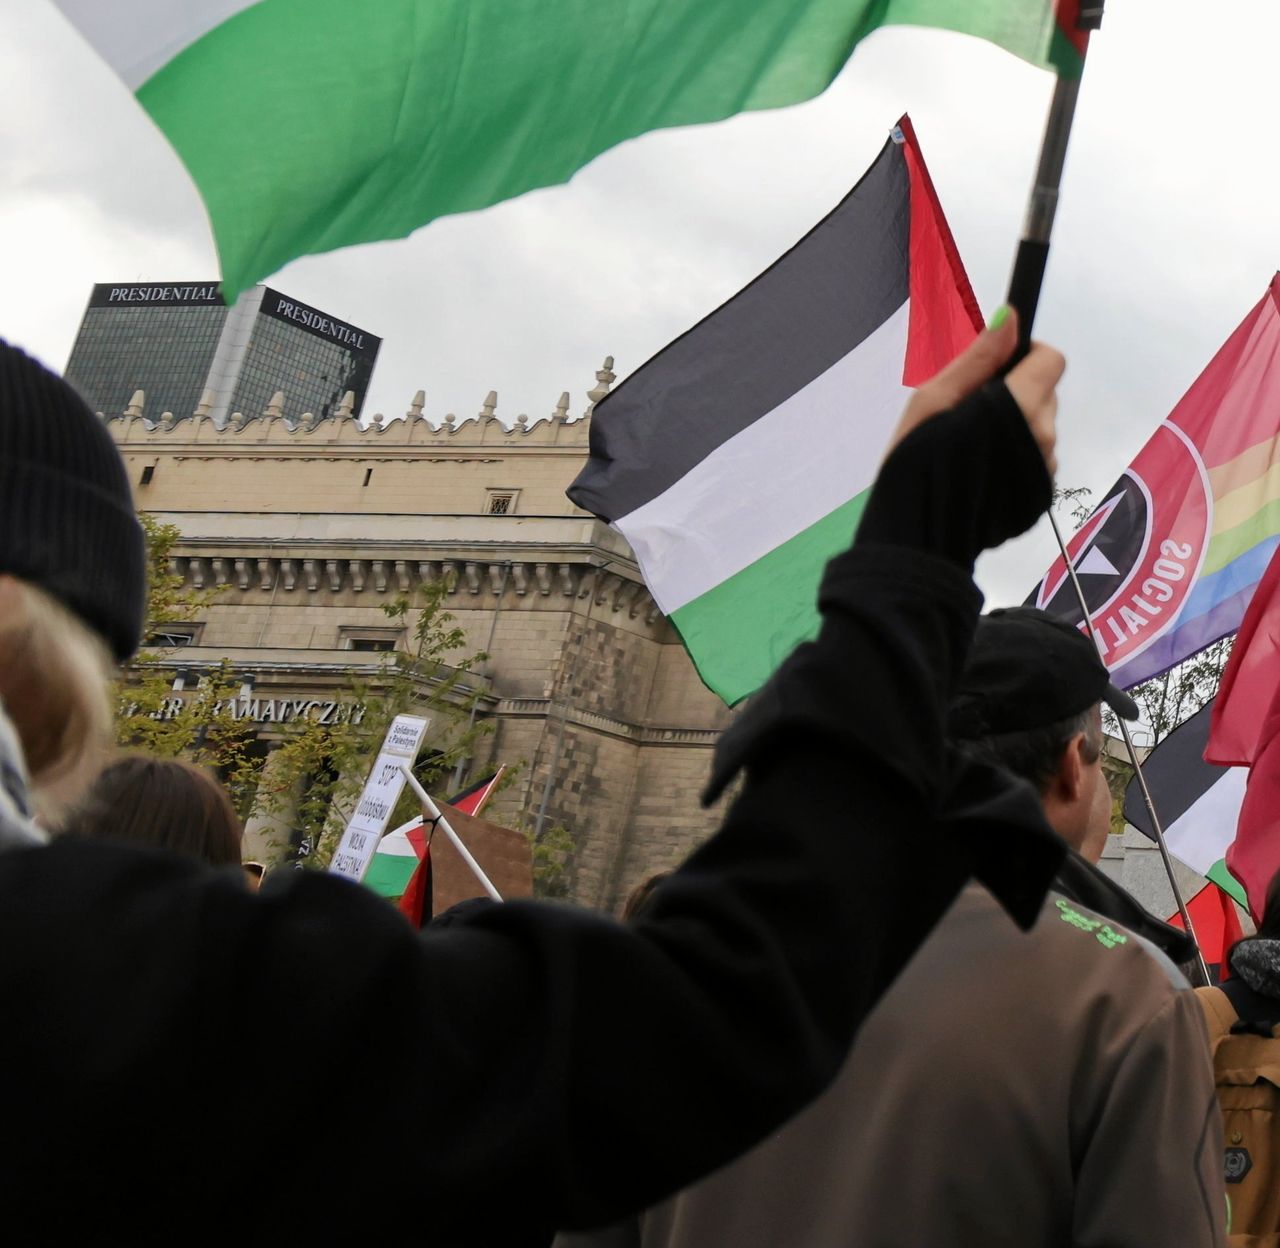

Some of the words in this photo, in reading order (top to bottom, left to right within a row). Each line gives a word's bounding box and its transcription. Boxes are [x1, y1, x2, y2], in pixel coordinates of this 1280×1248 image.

[109, 286, 217, 302] PRESIDENTIAL
[276, 299, 364, 350] PRESIDENTIAL
[378, 764, 398, 786] STOP
